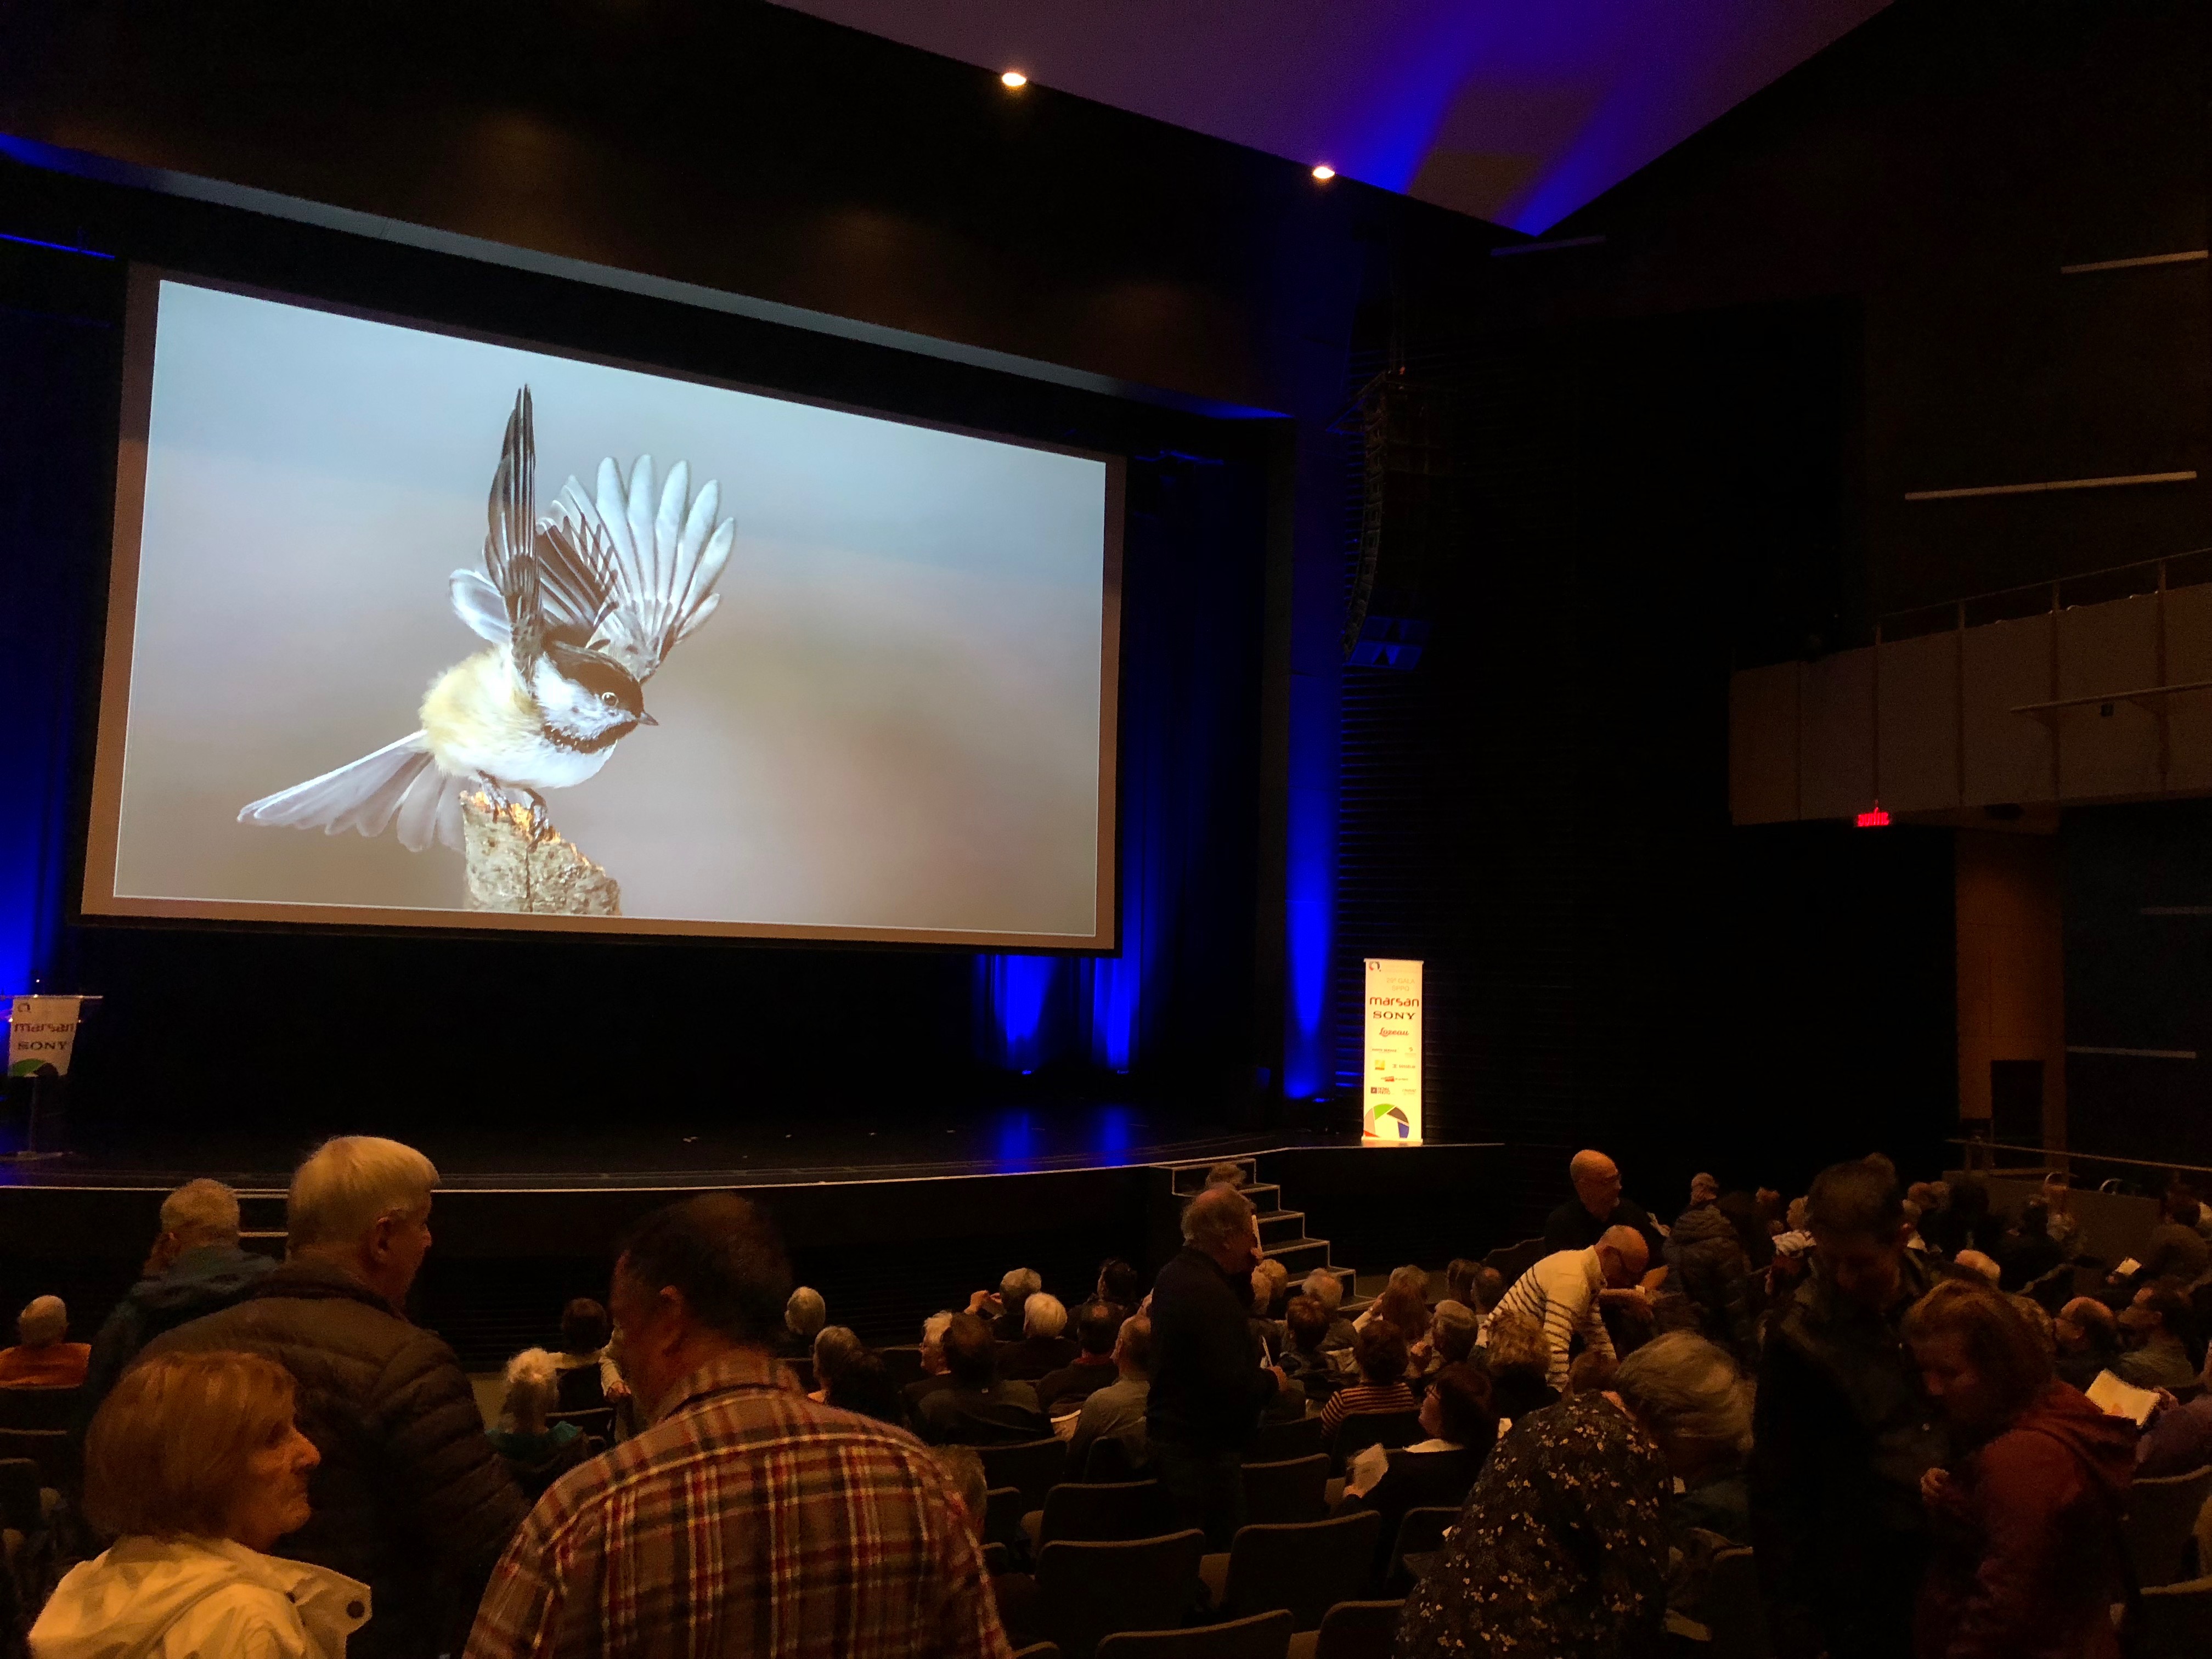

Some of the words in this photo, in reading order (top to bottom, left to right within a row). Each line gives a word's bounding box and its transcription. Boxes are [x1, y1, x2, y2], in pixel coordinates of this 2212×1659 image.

[1369, 996, 1419, 1007] marsan
[1373, 1010, 1416, 1020] SONY
[14, 1023, 73, 1032] marsan
[1379, 1027, 1409, 1037] Lozeau
[18, 1041, 67, 1050] SONY
